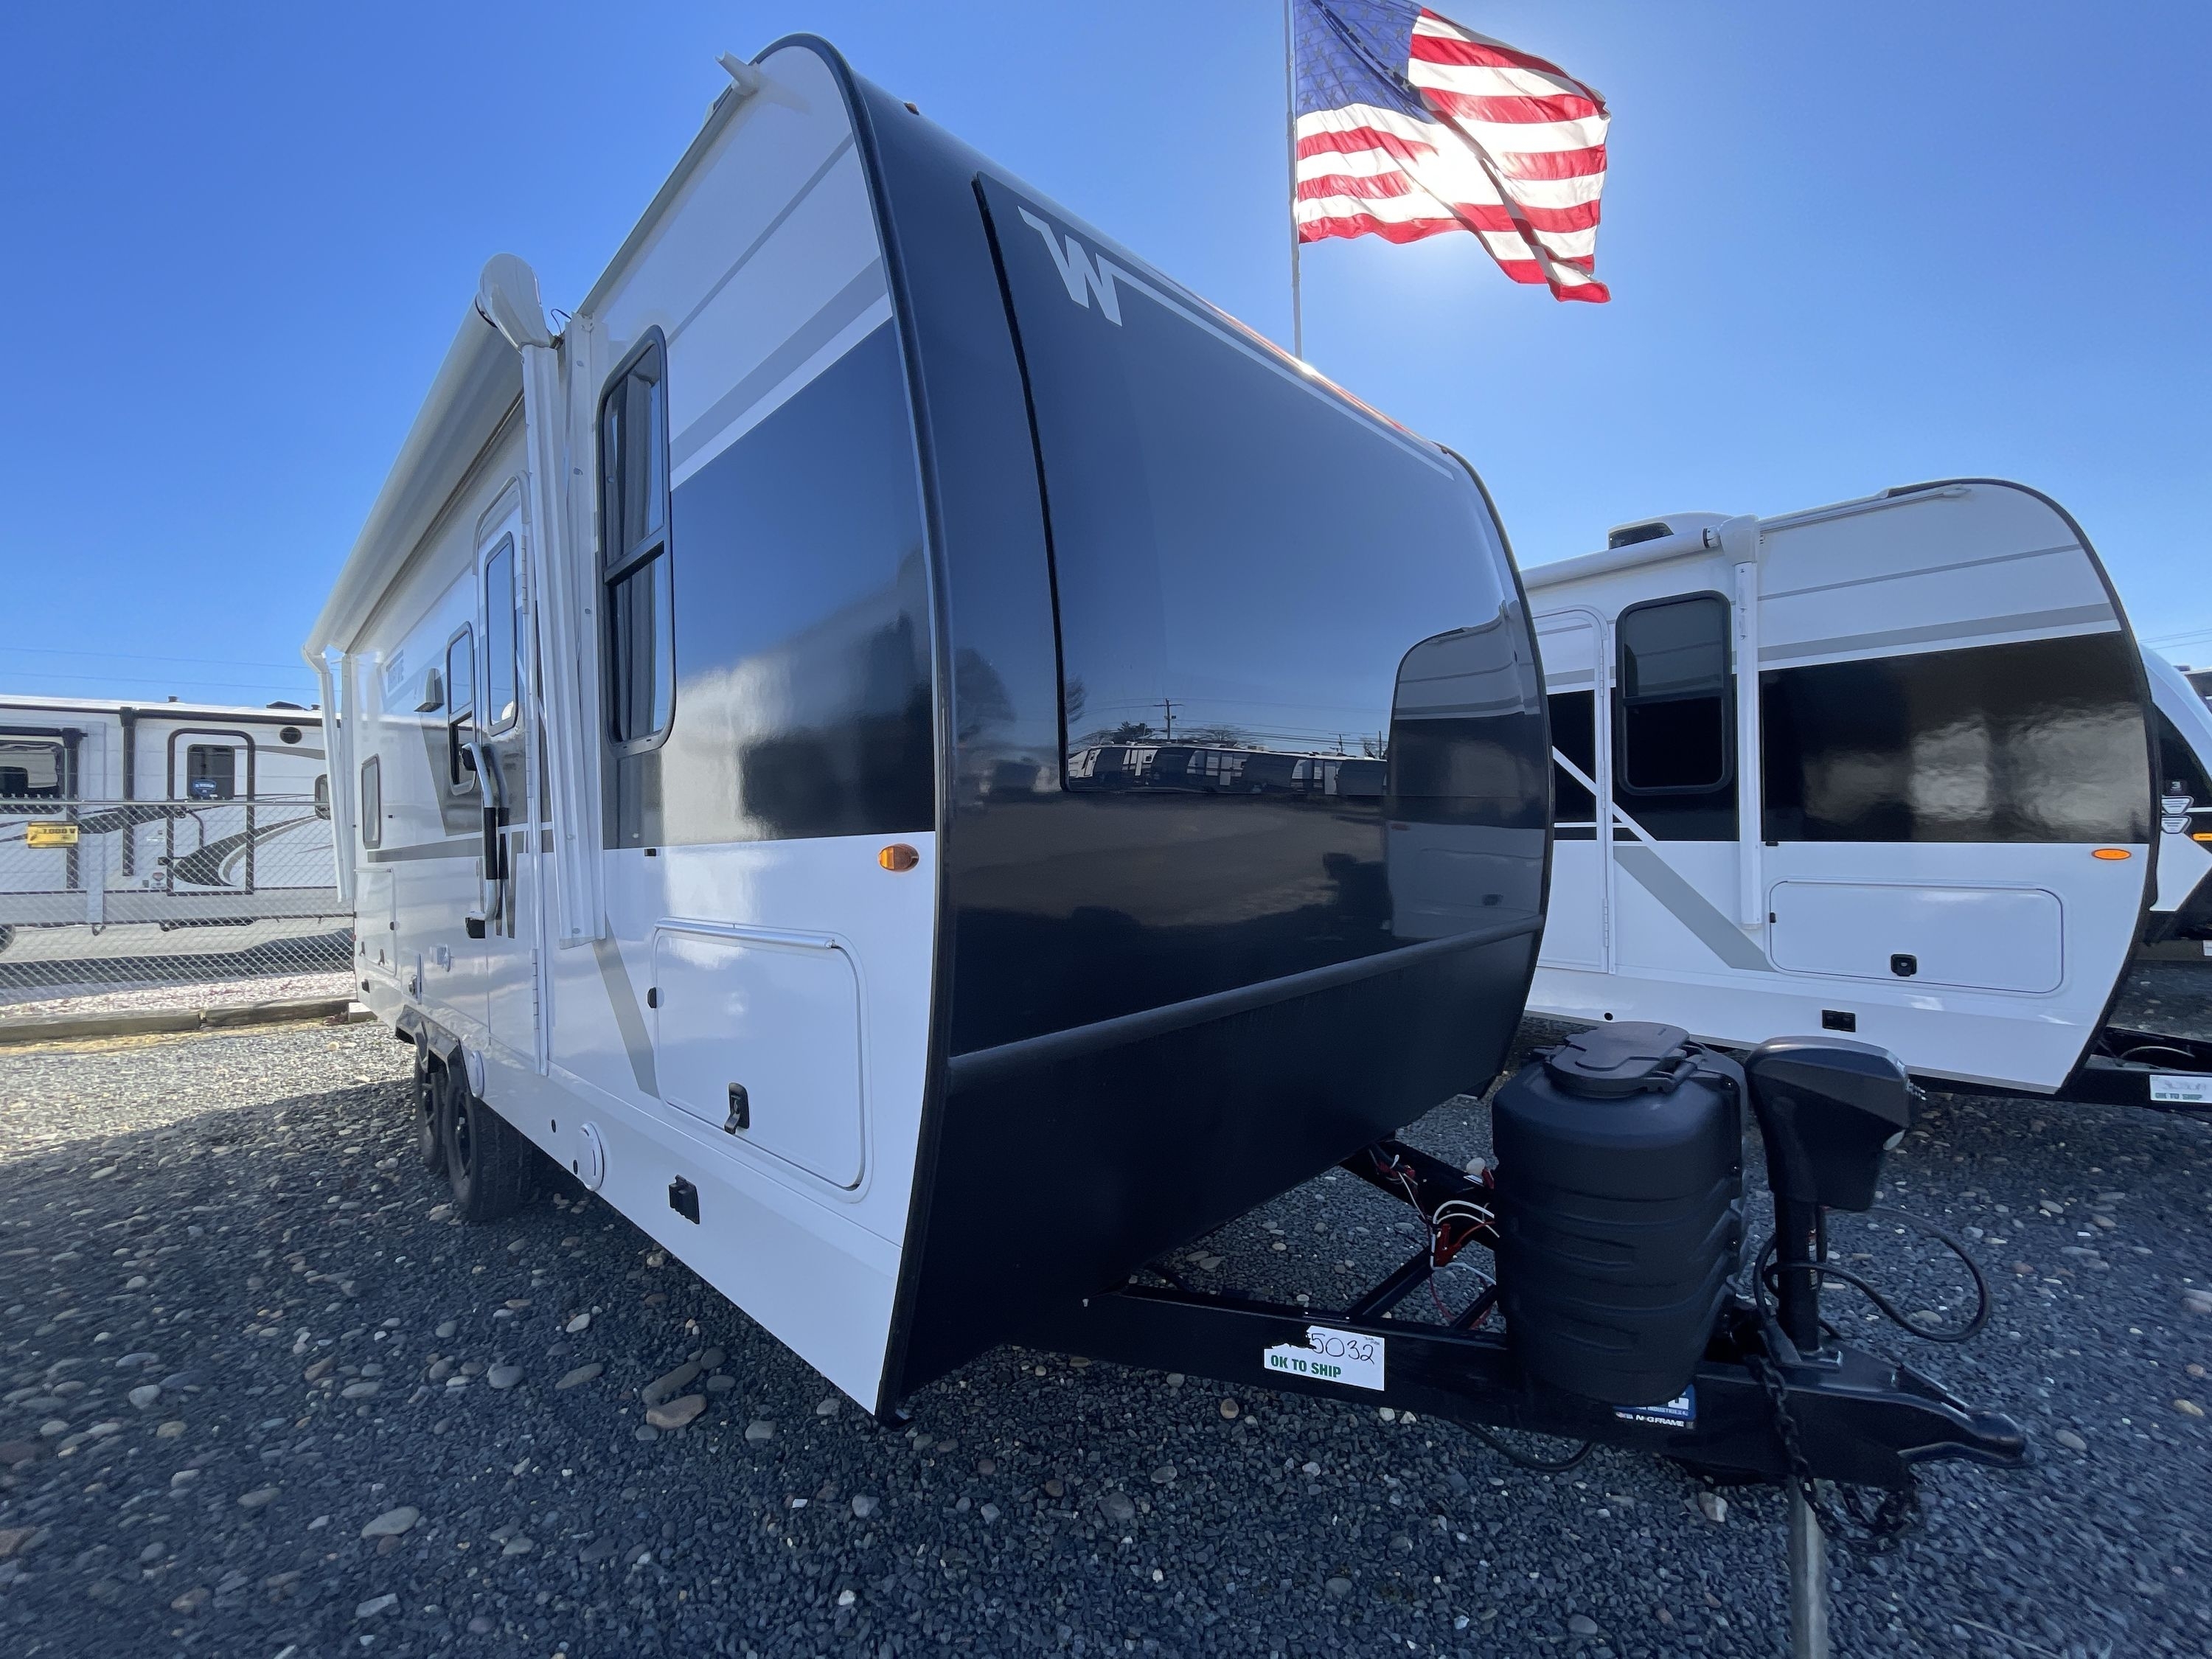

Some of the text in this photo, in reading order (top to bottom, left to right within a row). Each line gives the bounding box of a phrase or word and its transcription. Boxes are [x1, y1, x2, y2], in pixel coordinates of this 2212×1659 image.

[1311, 1332, 1375, 1365] 5032
[1270, 1354, 1341, 1378] OK TO SHIP
[1655, 1417, 1685, 1427] FRAME
